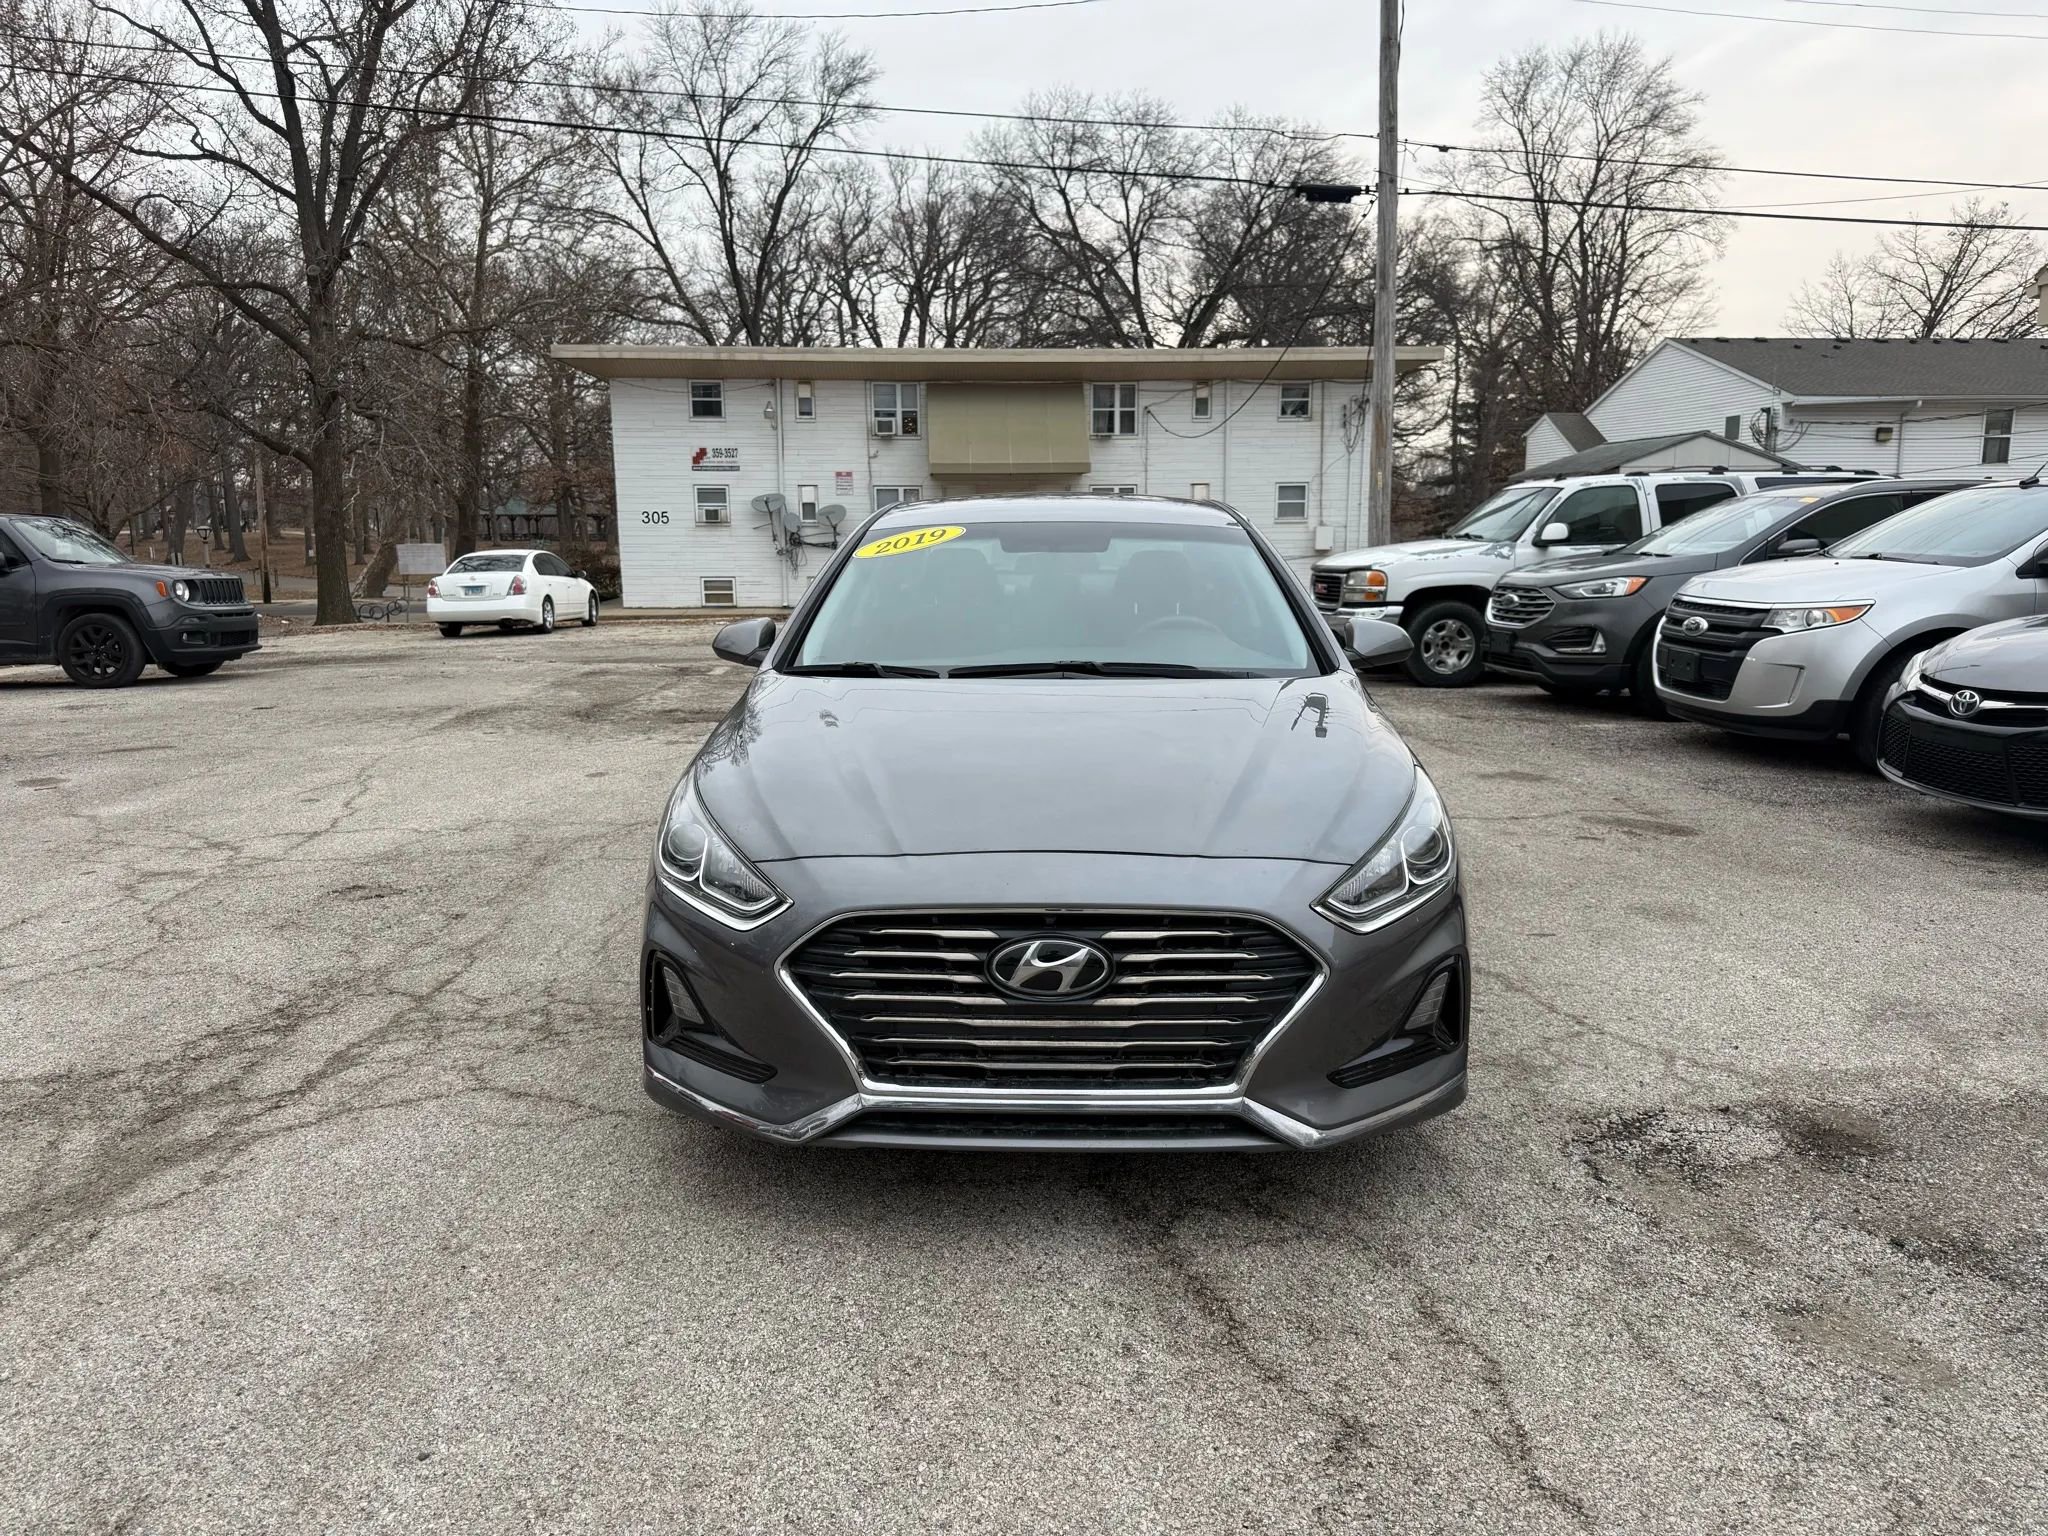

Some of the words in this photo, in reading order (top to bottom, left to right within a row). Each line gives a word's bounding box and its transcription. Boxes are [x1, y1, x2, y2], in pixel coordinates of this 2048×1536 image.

[711, 447, 738, 458] 359-3527
[641, 511, 669, 524] 305
[873, 529, 947, 555] 2019
